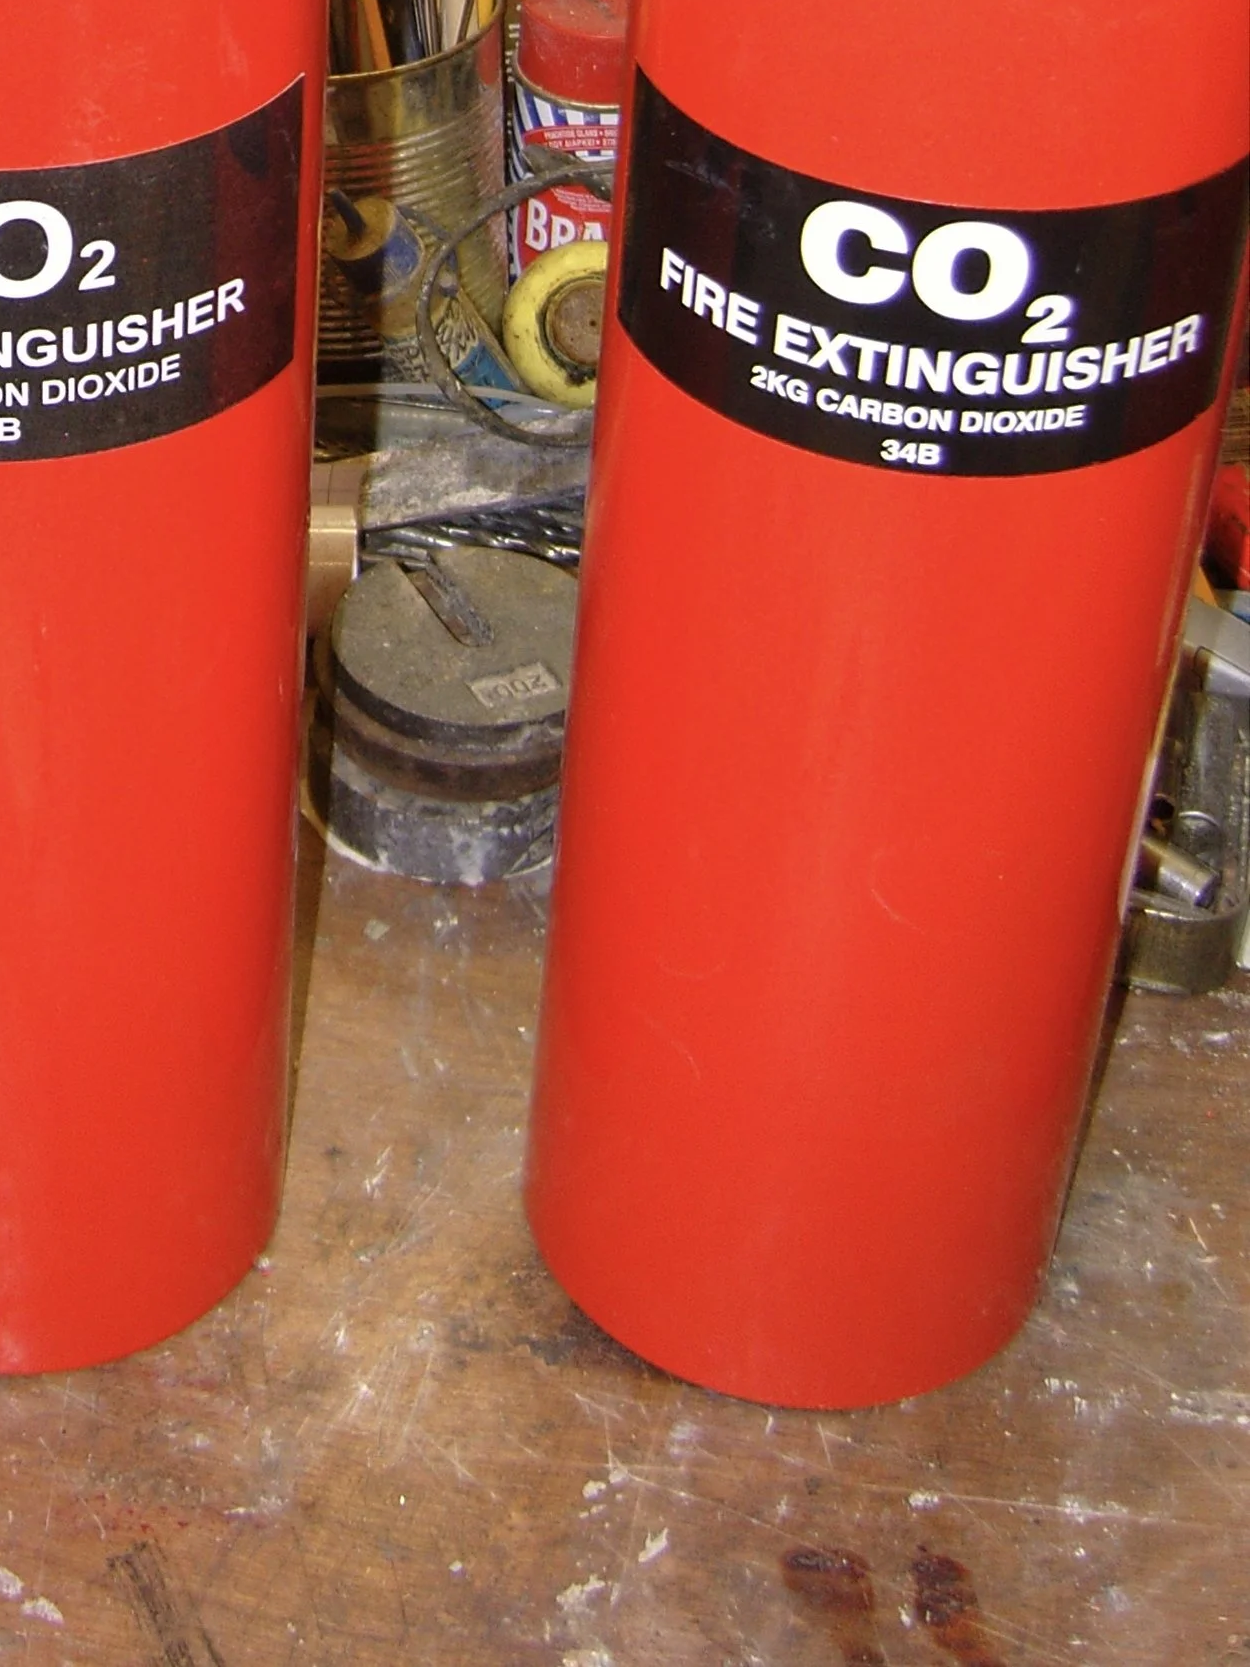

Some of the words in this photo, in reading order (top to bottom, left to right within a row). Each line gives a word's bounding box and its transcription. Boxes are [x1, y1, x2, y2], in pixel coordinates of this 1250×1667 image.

[526, 198, 605, 251] BRA
[801, 200, 1076, 344] CO2
[660, 248, 761, 346] FIRE
[774, 313, 1203, 397] EXTINGUISHER
[42, 354, 182, 405] DIOXIDE
[750, 366, 809, 404] 2KG
[816, 388, 952, 432] CARBON
[959, 405, 1086, 433] DIOXIDE
[880, 439, 940, 466] 34B
